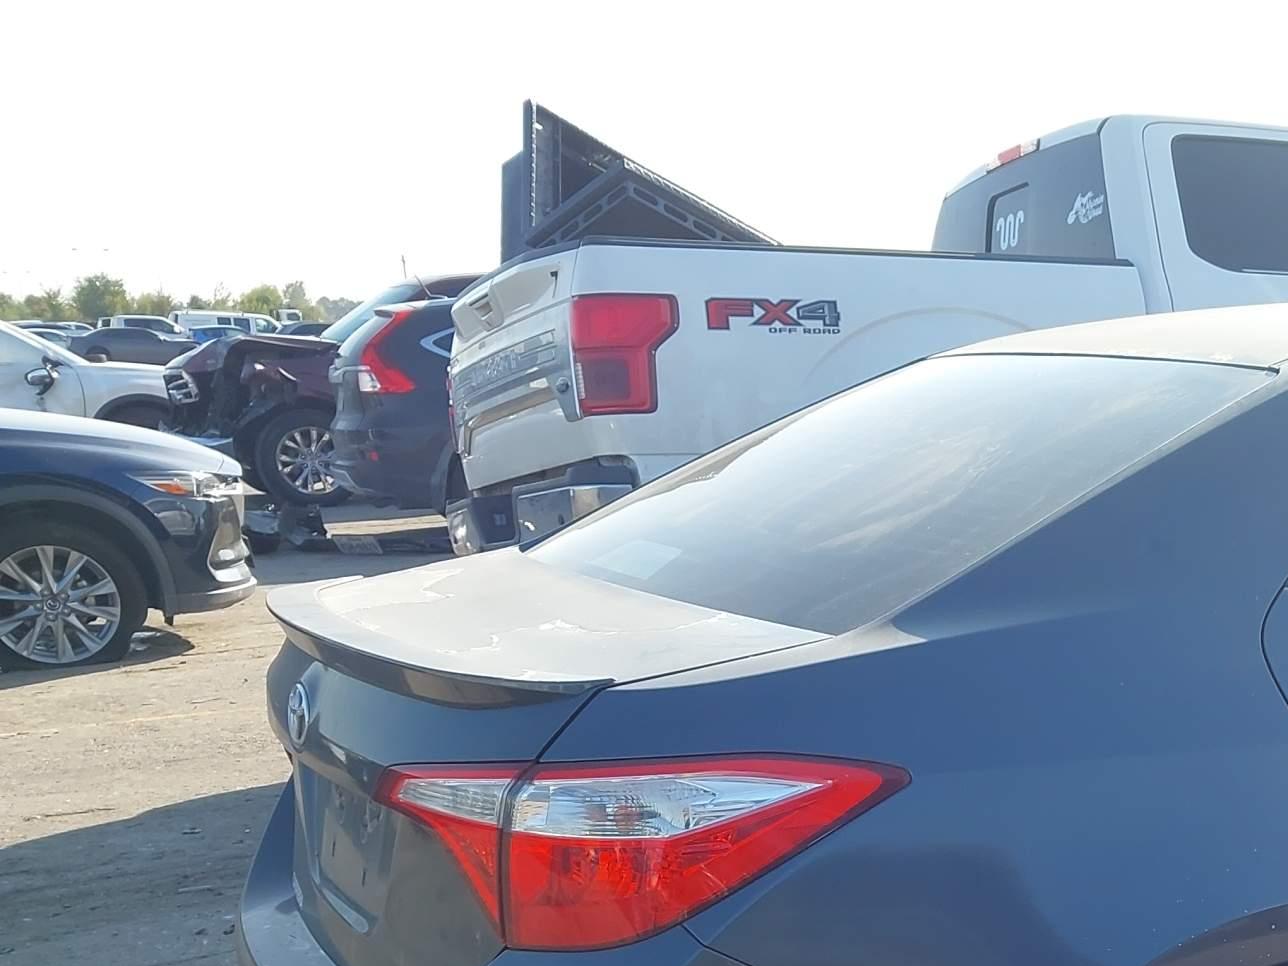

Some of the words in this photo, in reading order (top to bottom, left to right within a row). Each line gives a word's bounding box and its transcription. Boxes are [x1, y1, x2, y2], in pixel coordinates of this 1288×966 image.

[705, 297, 840, 330] FX4
[768, 327, 798, 335] OFF
[803, 327, 841, 335] ROAD
